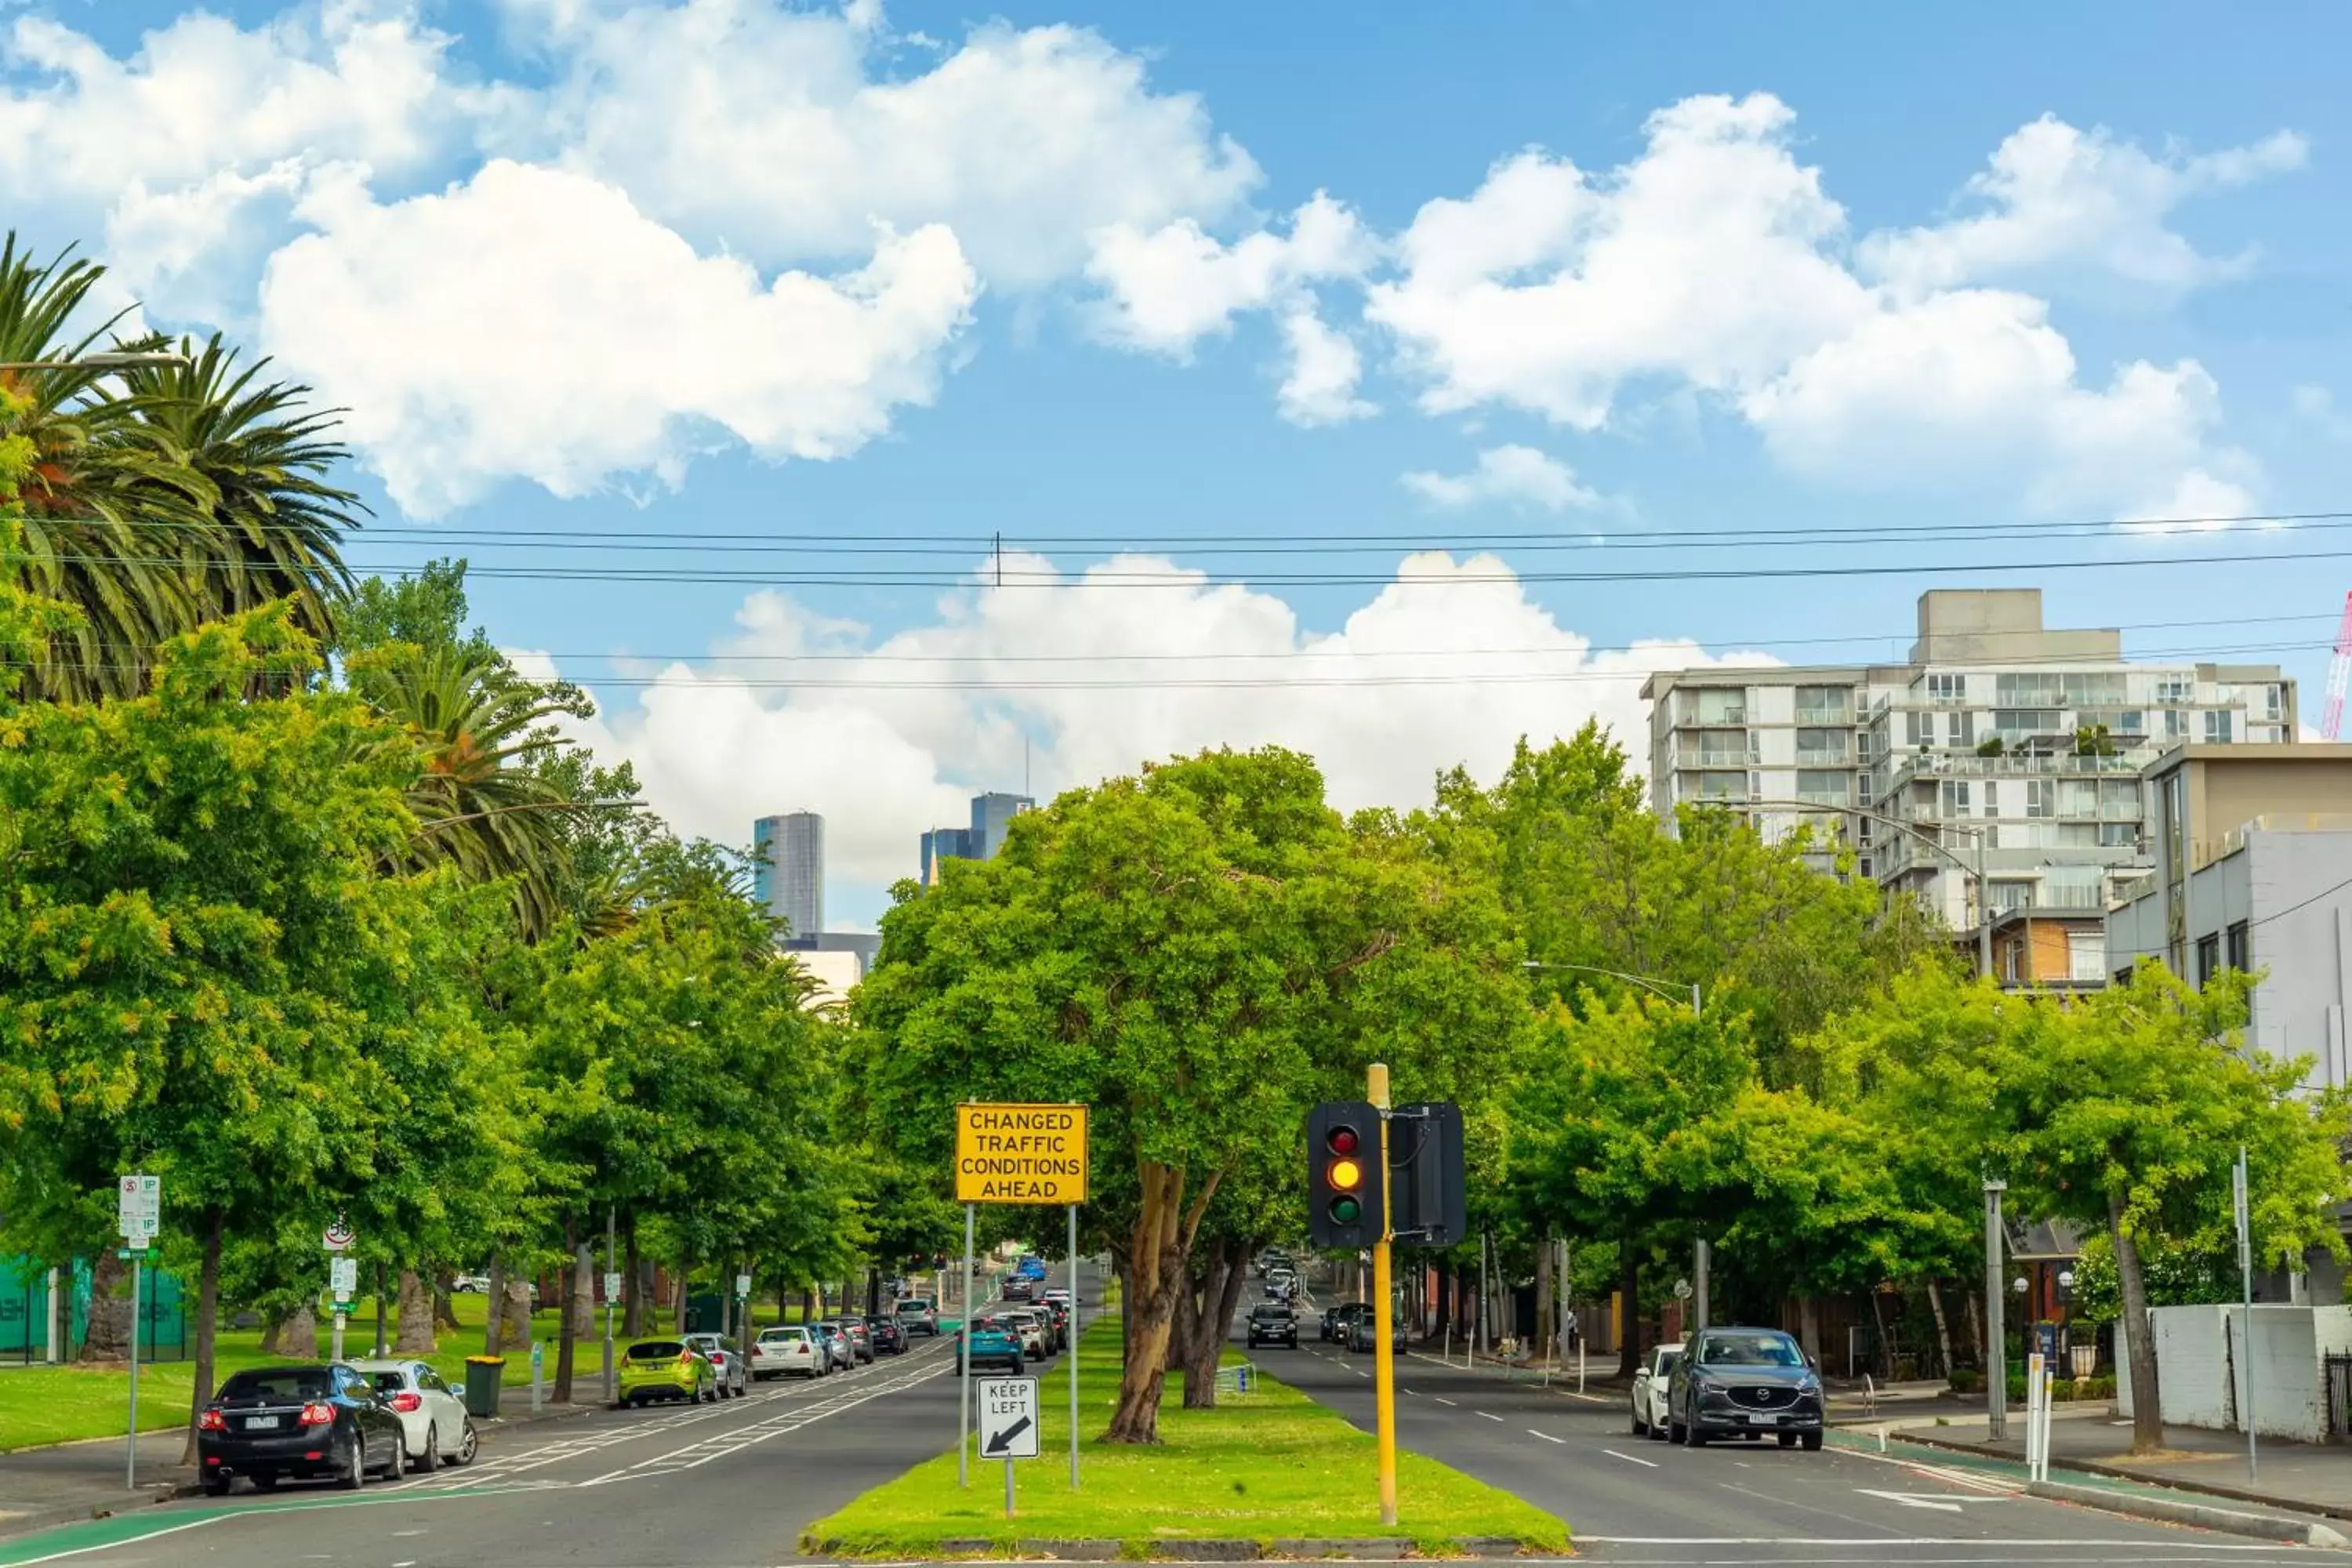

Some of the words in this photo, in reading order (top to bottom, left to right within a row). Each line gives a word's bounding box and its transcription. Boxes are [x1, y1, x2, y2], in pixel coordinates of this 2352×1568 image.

[970, 1112, 1073, 1130] CHANGED
[976, 1135, 1065, 1152] TRAFFIC
[962, 1158, 1080, 1175] CONDITIONS
[982, 1181, 1058, 1197] AHEAD
[143, 1219, 155, 1229] 1P
[990, 1385, 1028, 1398] KEEP
[992, 1401, 1025, 1414] LEFT
